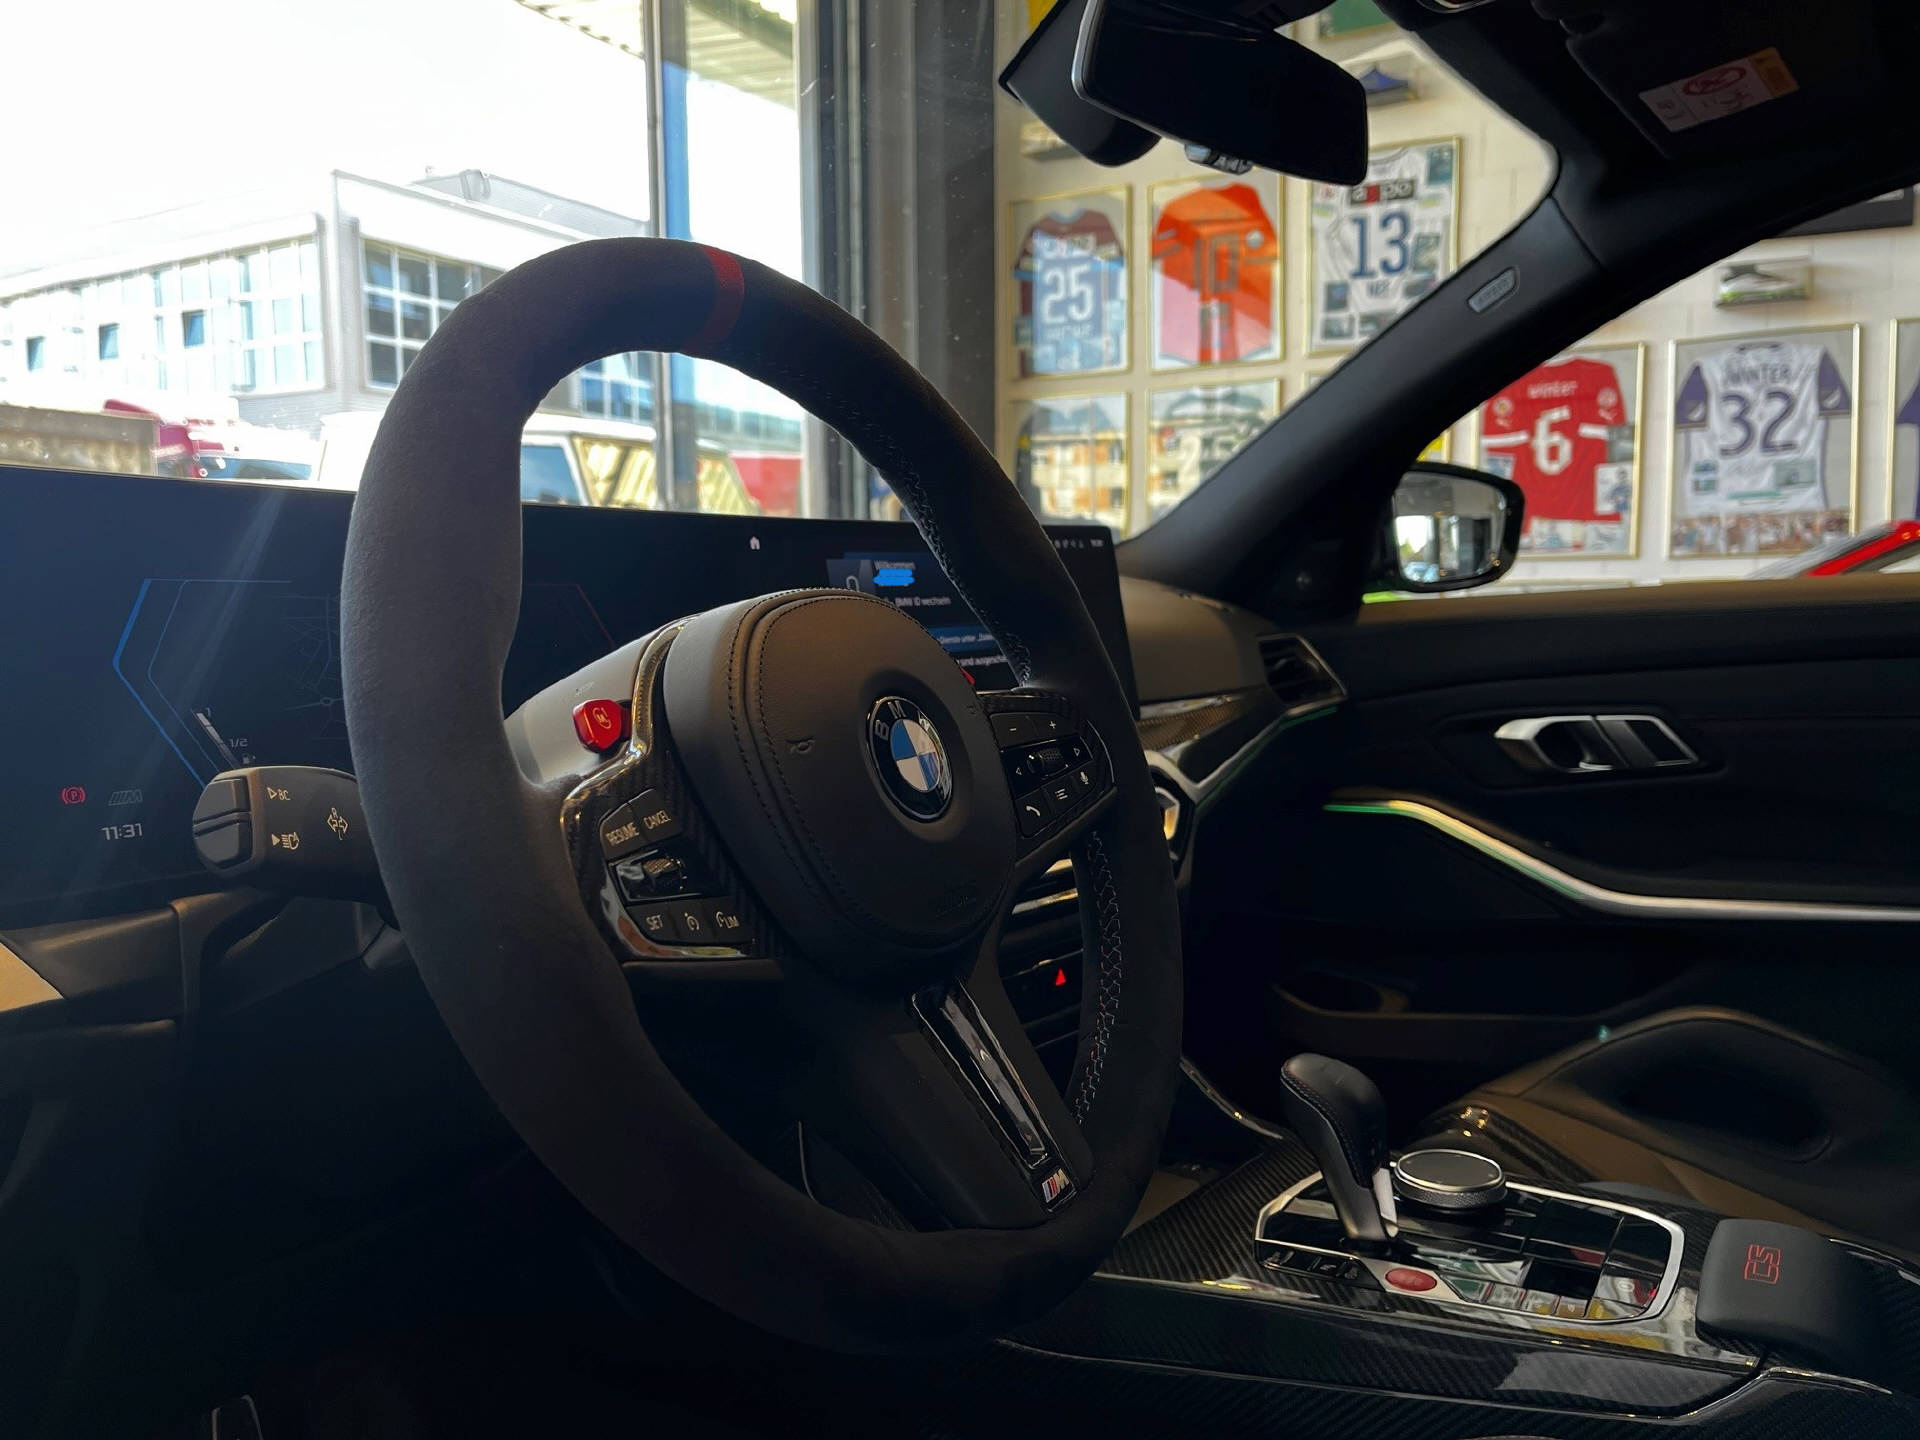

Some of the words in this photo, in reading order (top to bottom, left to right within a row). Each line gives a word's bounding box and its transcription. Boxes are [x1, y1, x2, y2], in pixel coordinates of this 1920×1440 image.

[1351, 210, 1412, 279] 13
[1041, 262, 1094, 325] 25
[1531, 405, 1574, 476] 6
[1719, 386, 1800, 459] 32
[101, 822, 144, 841] 11:31
[605, 821, 640, 846] RESUME
[643, 809, 672, 830] CANCEL
[646, 914, 664, 931] SET
